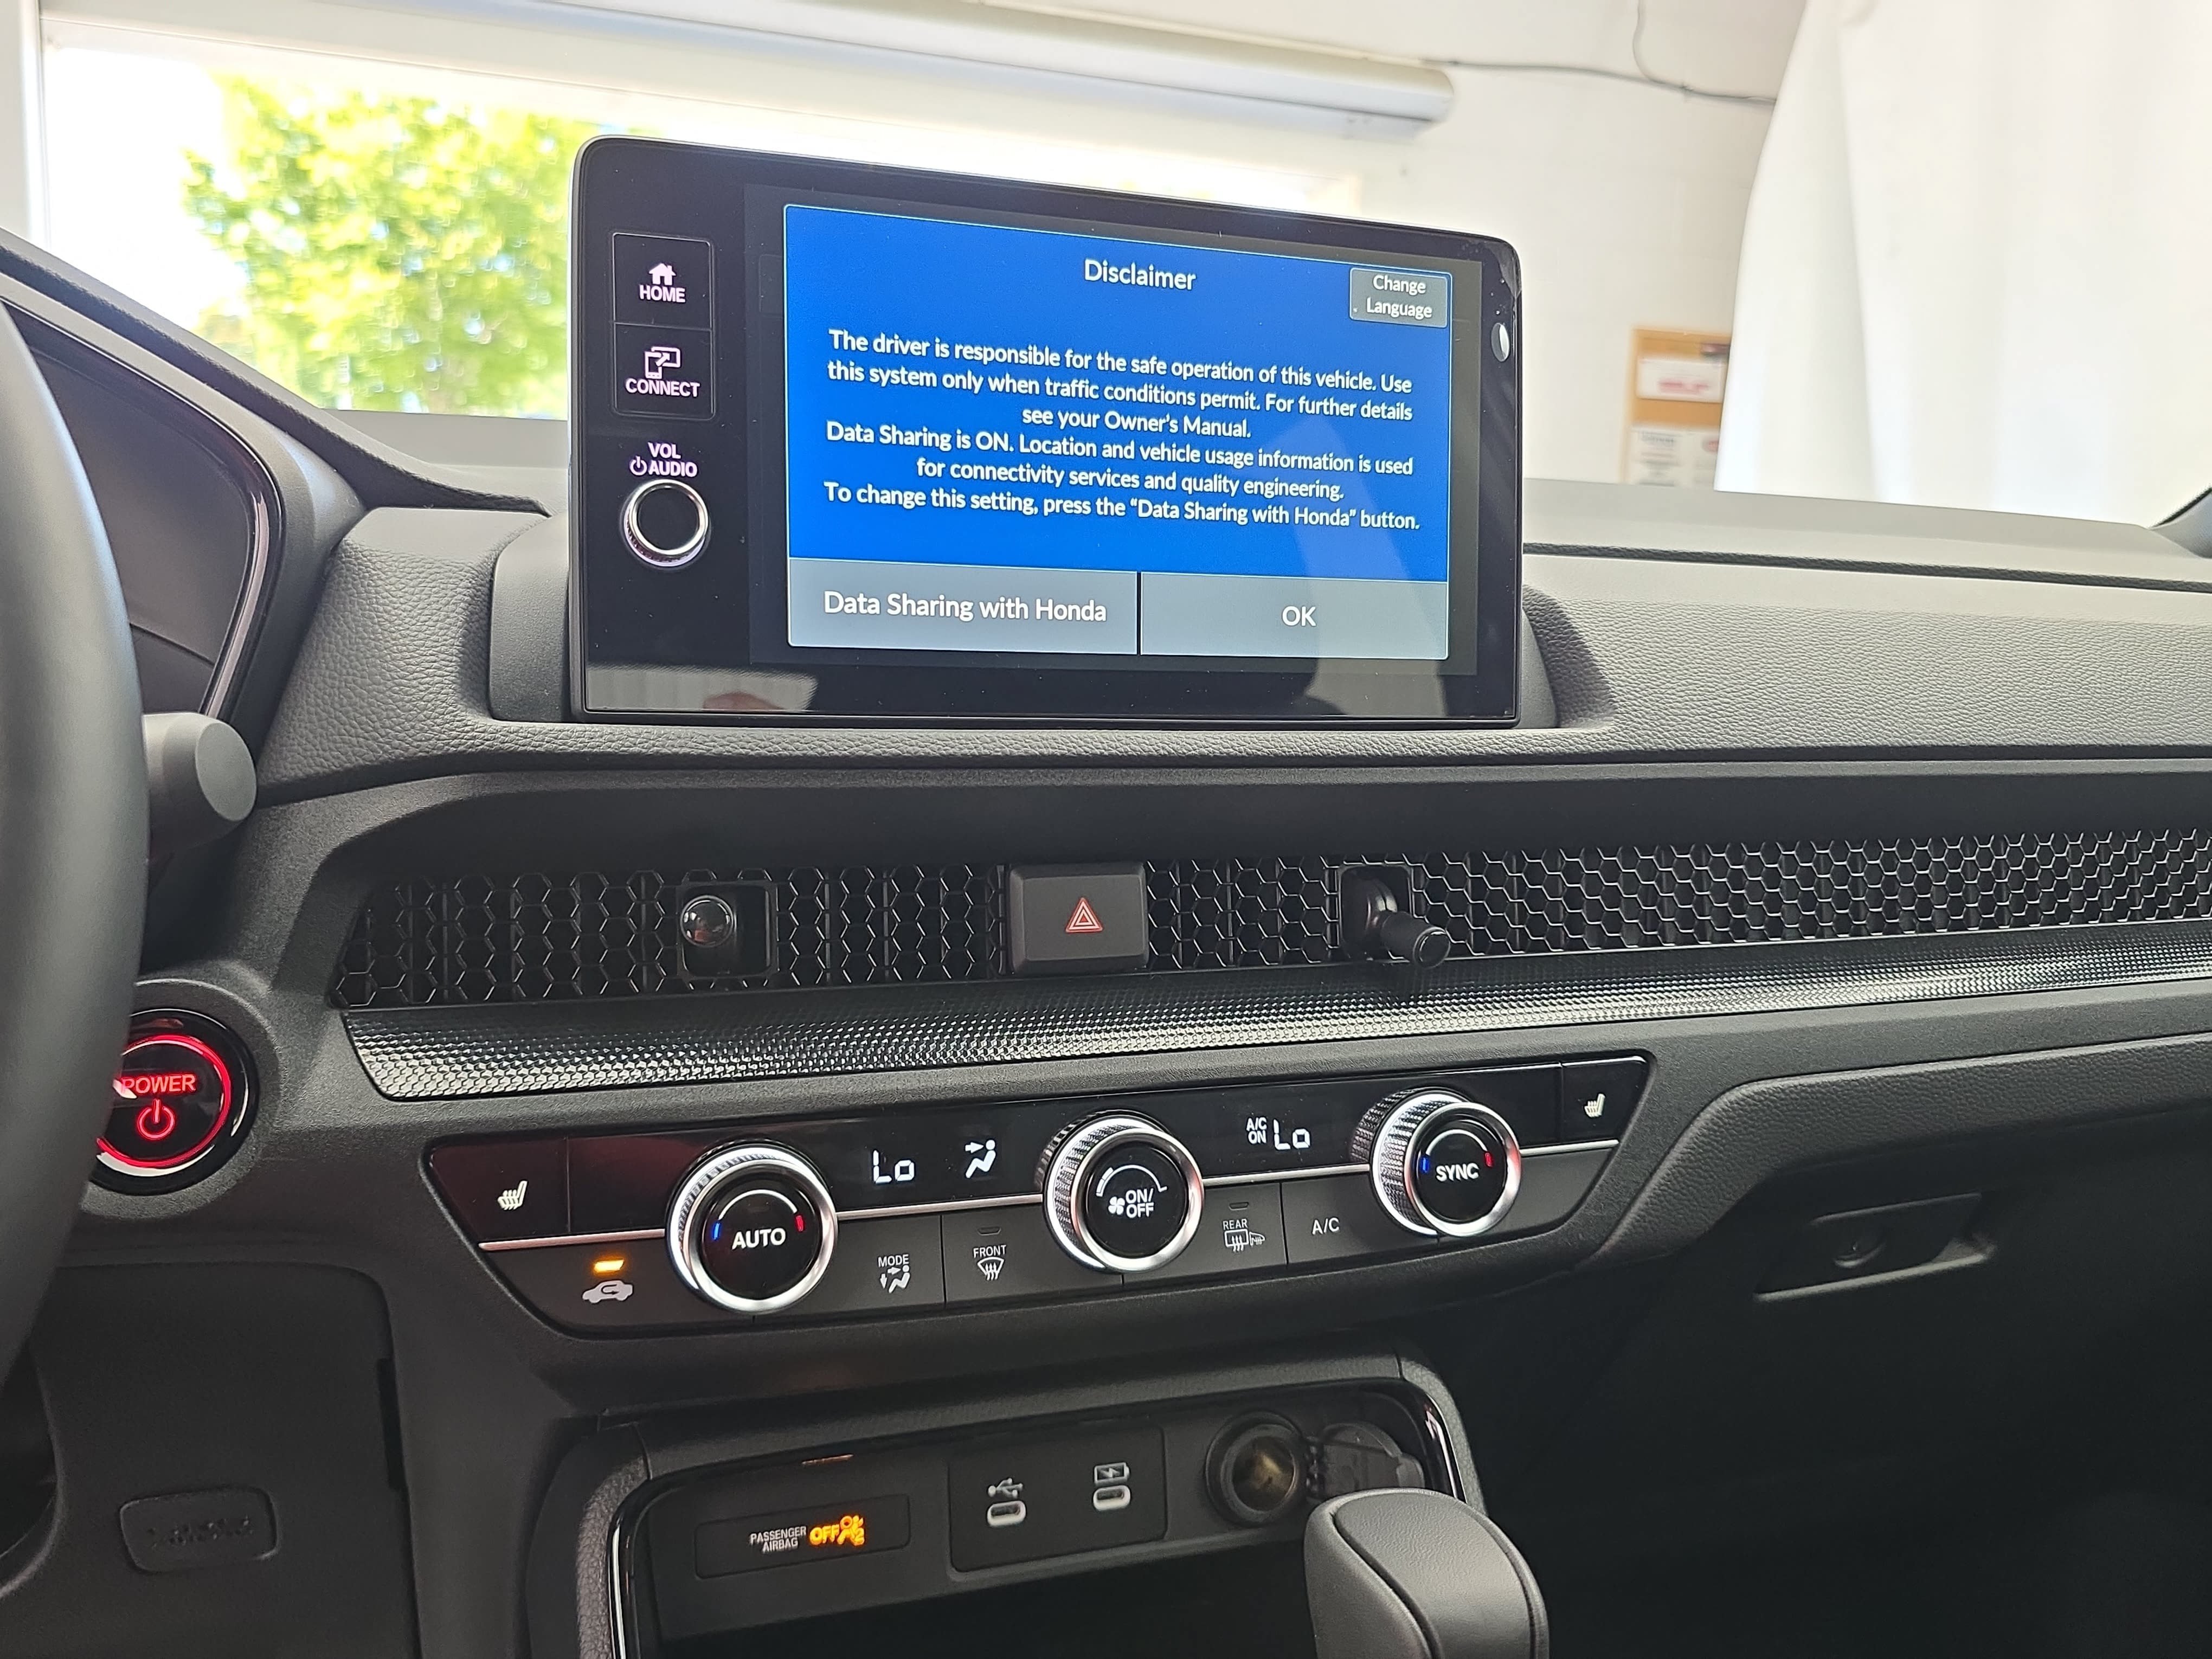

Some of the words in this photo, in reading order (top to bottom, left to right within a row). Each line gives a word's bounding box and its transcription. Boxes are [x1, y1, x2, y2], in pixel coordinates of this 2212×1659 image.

[1084, 258, 1197, 290] Disclaimer
[639, 284, 686, 303] HOME
[1372, 274, 1427, 296] Change
[1366, 297, 1433, 320] Language
[828, 329, 869, 351] The
[872, 332, 931, 357] driver
[935, 337, 950, 358] is
[954, 344, 1060, 367] responsible
[1064, 349, 1092, 369] for
[1096, 351, 1127, 372] the
[1130, 356, 1167, 375] safe
[1171, 361, 1254, 382] operation
[1258, 365, 1277, 384] of
[1280, 366, 1312, 386] this
[1315, 369, 1377, 391] vehicle.
[1381, 374, 1412, 394] Use
[626, 378, 700, 397] CONNECT
[827, 360, 865, 382] this
[869, 366, 937, 387] system
[942, 370, 984, 394] only
[987, 372, 1040, 395] when
[1044, 377, 1099, 399] traffic
[1103, 383, 1196, 406] conditions
[1200, 390, 1261, 410] permit.
[1265, 393, 1295, 413] For
[1297, 395, 1357, 417] further
[1360, 400, 1413, 421] details
[1022, 409, 1054, 425] see
[1057, 410, 1101, 430] your
[1183, 415, 1251, 438] Manual.
[647, 441, 681, 459] VOL
[827, 421, 874, 443] Data
[879, 424, 952, 452] Sharing
[956, 429, 972, 449] is
[975, 431, 1014, 452] ON.
[1019, 434, 1097, 457] Location
[1101, 440, 1135, 459] and
[1139, 442, 1201, 463] vehicle
[1205, 449, 1254, 470] usage
[1258, 448, 1354, 472] information
[1359, 454, 1372, 473] is
[1375, 457, 1413, 475] used
[648, 460, 698, 478] AUDIO
[916, 457, 946, 478] for
[950, 463, 1065, 488] connectivity
[1069, 468, 1140, 488] services
[1143, 471, 1176, 491] and
[1181, 474, 1240, 497] quality
[1243, 477, 1345, 502] engineering.
[824, 481, 852, 502] To
[856, 484, 927, 510] change
[930, 487, 967, 509] this
[970, 491, 1039, 516] setting,
[1043, 498, 1092, 516] press
[1095, 496, 1126, 517] the
[1184, 501, 1248, 525] Sharing
[1251, 505, 1290, 524] with
[1360, 509, 1420, 530] button.
[824, 590, 880, 615] Data
[887, 593, 974, 622] Sharing
[979, 596, 1029, 620] with
[1036, 598, 1107, 622] Honda
[1282, 606, 1316, 626] OK
[121, 1074, 196, 1092] POWER
[1246, 1117, 1267, 1131] A/C
[1248, 1130, 1267, 1144] ON
[1436, 1162, 1480, 1182] SYNC
[1125, 1188, 1154, 1204] ON/
[1126, 1203, 1154, 1218] OFF
[1223, 1218, 1248, 1230] REAR
[1311, 1217, 1340, 1235] A/C
[731, 1227, 786, 1250] AUTO
[877, 1253, 910, 1268] MODE
[973, 1244, 1006, 1258] FRONT
[749, 1526, 807, 1545] PASSENGER
[809, 1524, 840, 1546] OFF
[762, 1536, 799, 1554] AIRBAG
